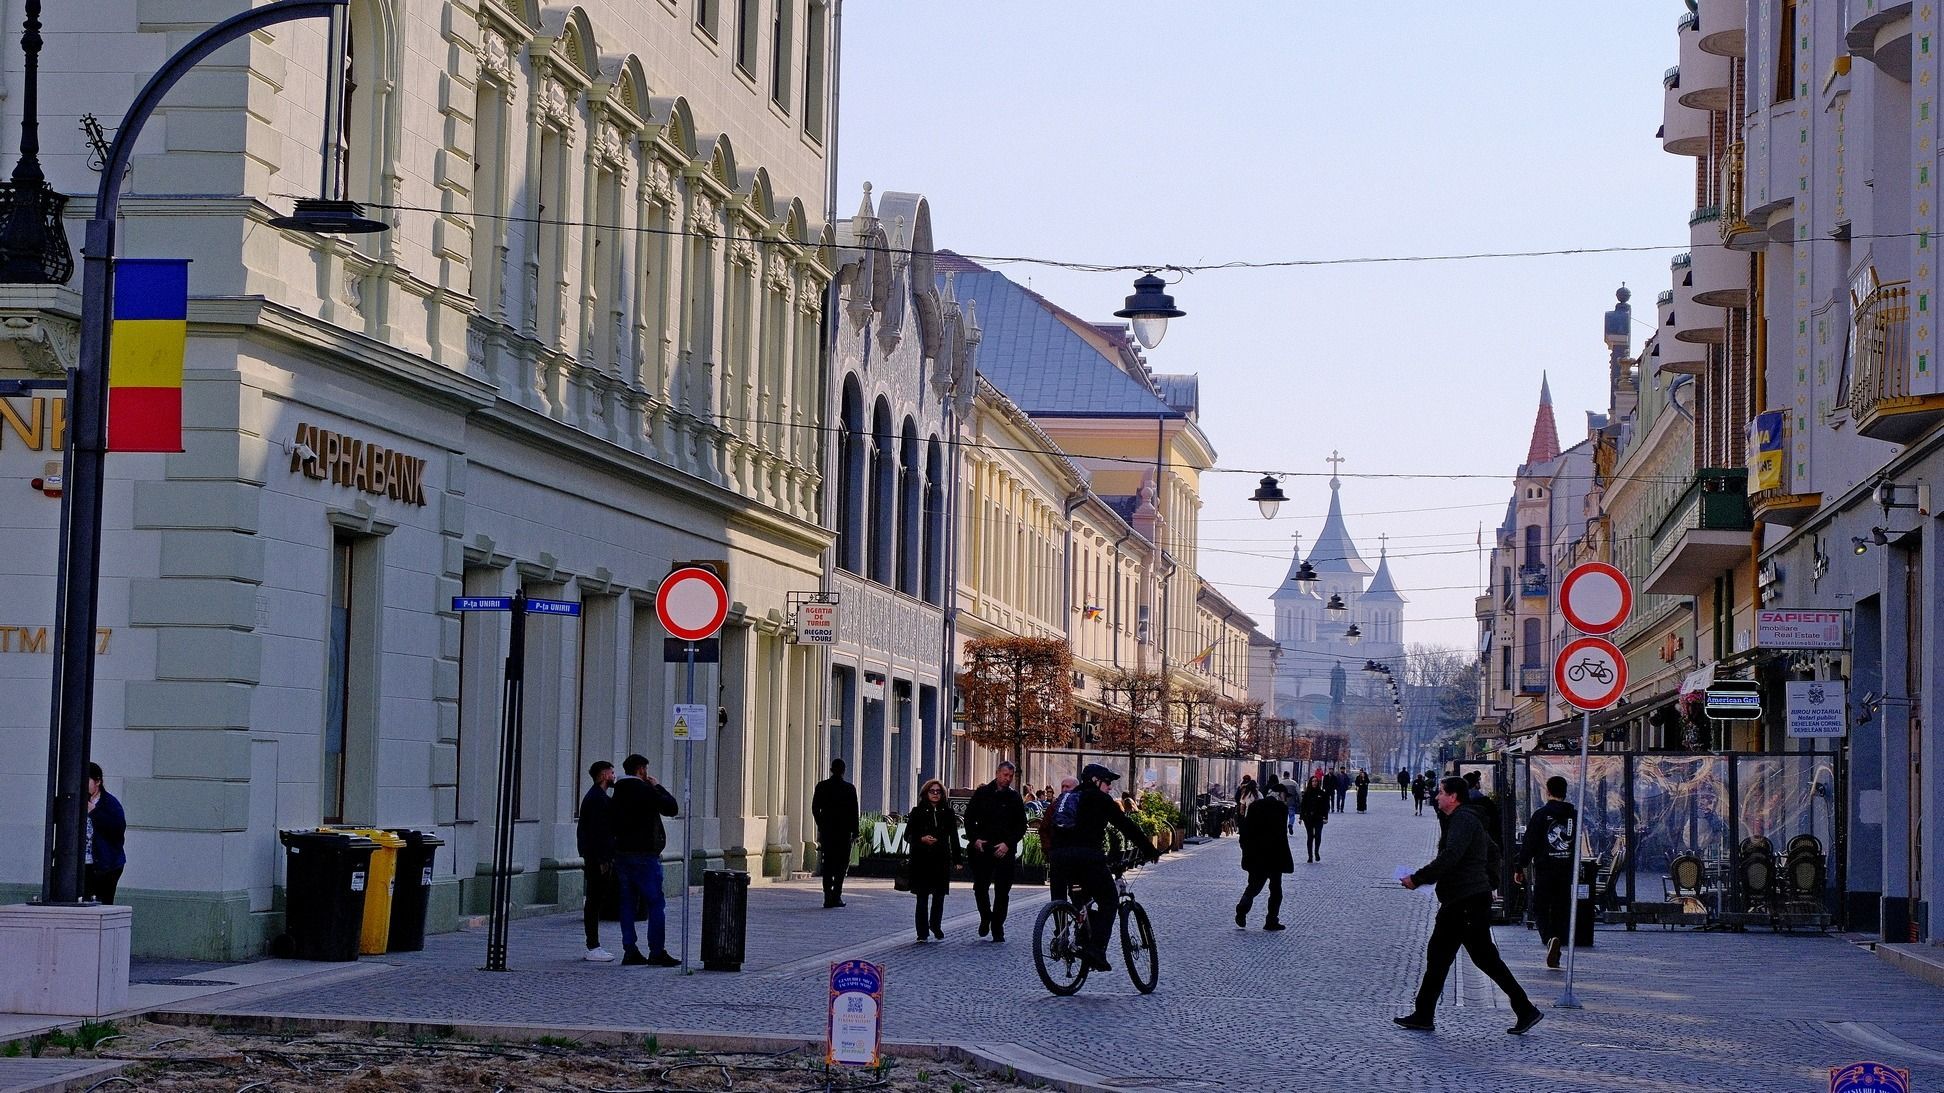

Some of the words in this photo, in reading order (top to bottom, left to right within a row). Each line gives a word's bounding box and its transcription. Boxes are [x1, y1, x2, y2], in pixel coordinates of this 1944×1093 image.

[290, 422, 367, 491] ALPHA
[366, 443, 427, 507] BANK
[479, 600, 500, 608] UNIRII
[550, 603, 571, 612] UNIRII
[1760, 613, 1839, 623] SAPIENT
[1743, 696, 1760, 704] Grill
